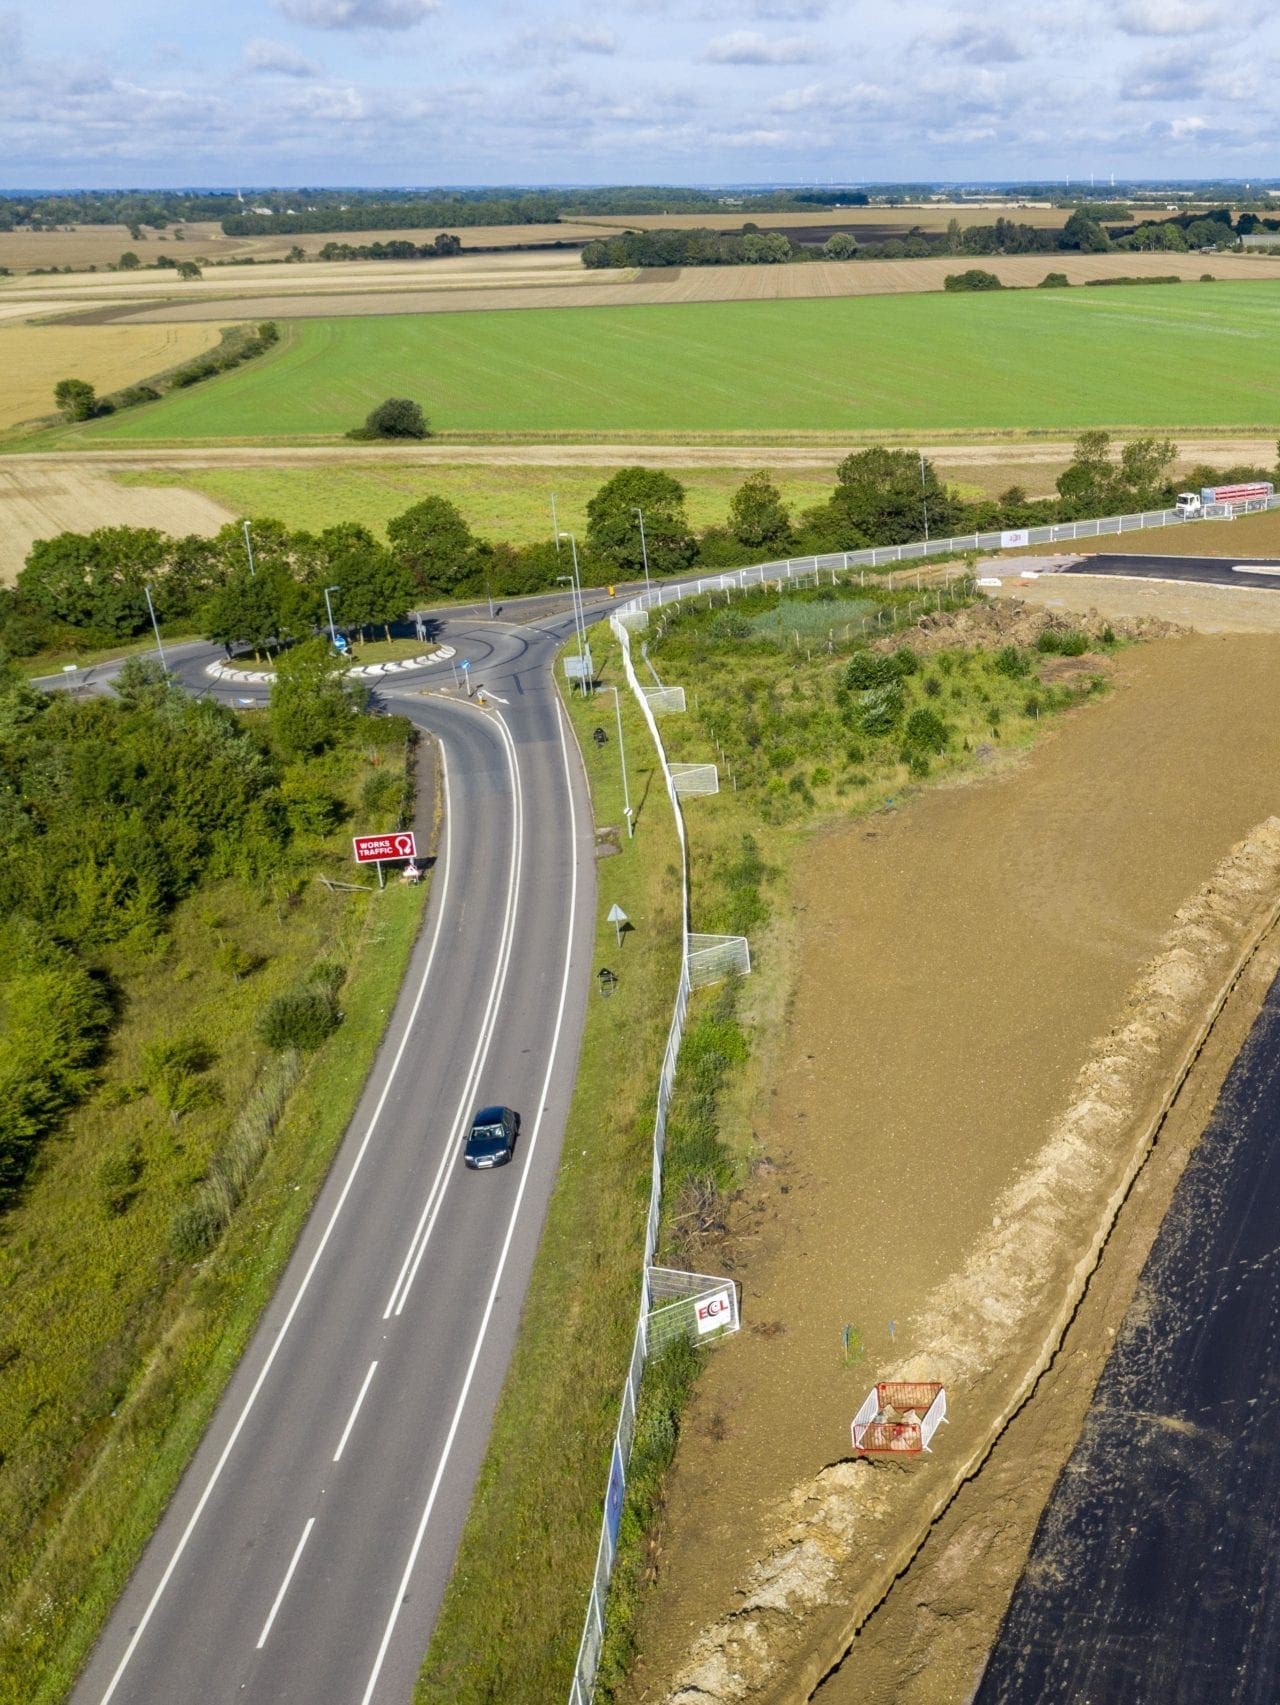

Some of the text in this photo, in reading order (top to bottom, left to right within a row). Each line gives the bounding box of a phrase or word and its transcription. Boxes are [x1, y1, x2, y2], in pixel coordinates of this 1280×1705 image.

[360, 840, 390, 849] WORKS
[359, 847, 393, 856] TRAFFIC
[699, 1300, 728, 1320] ECL
